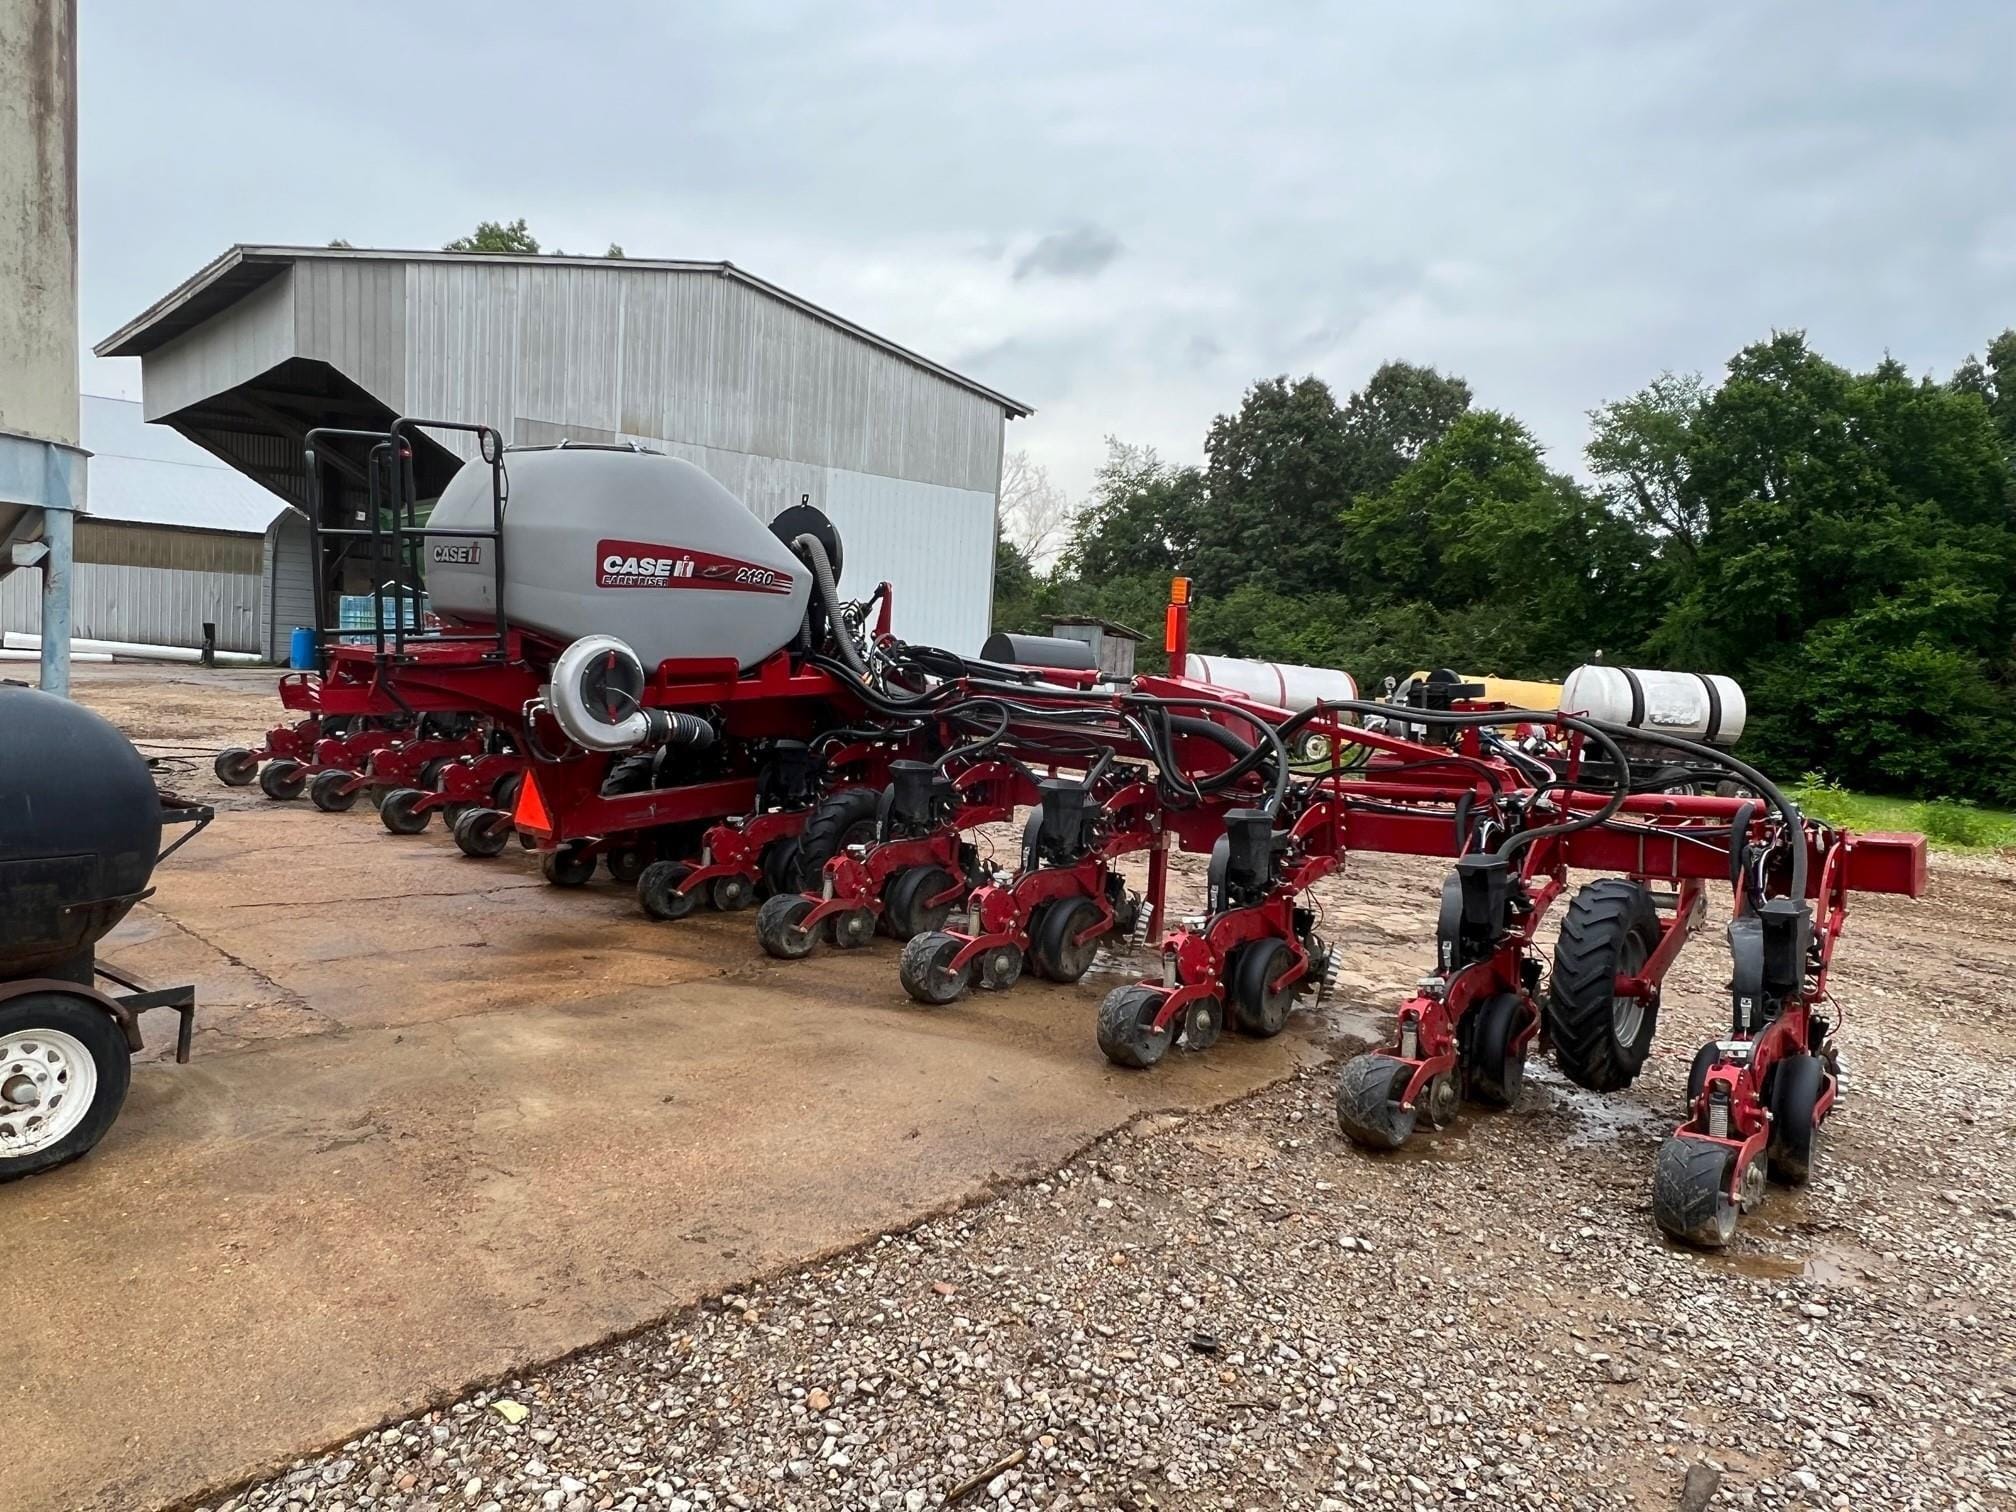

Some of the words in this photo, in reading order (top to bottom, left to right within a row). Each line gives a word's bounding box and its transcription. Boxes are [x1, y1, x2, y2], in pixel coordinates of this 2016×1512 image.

[433, 545, 467, 563] CASE
[603, 555, 673, 576] CASE
[602, 575, 638, 585] EARLY
[638, 577, 669, 587] RISER
[735, 566, 775, 586] 2130
